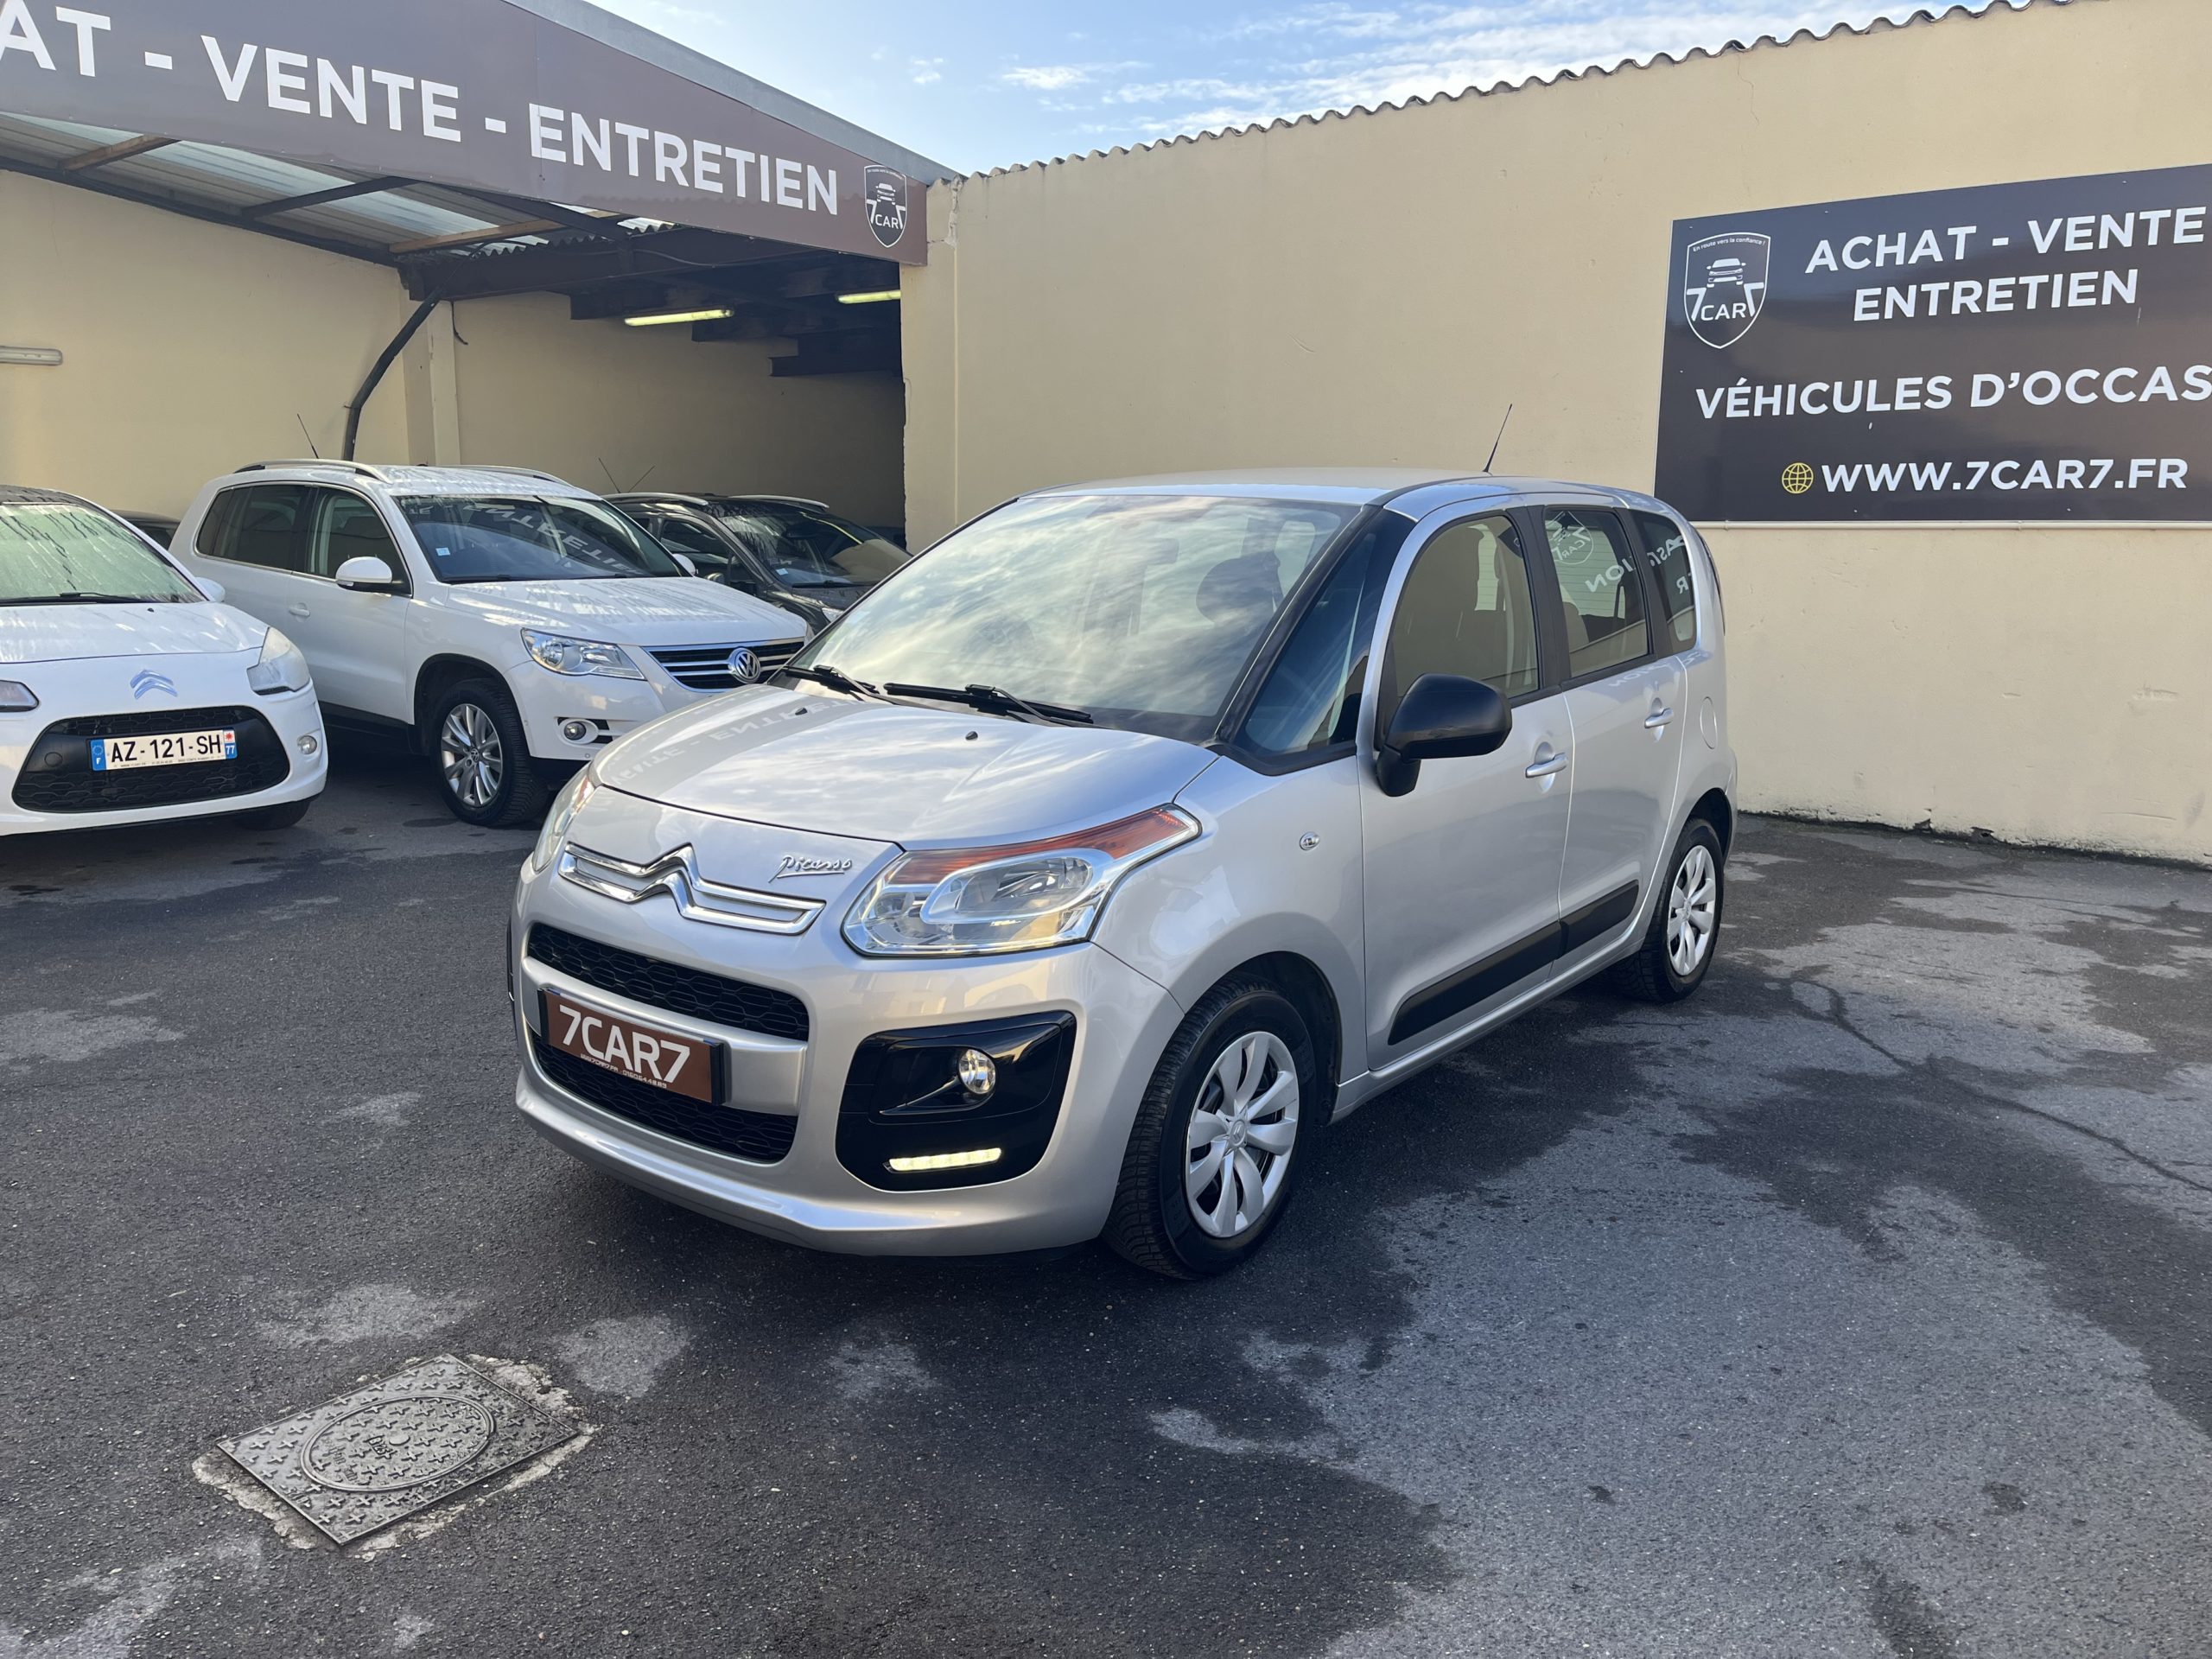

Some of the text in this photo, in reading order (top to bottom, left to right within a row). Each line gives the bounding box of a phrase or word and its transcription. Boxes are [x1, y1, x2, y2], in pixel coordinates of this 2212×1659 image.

[200, 35, 461, 143] VENTE
[528, 103, 837, 215] ENTRETIEN
[1700, 241, 1716, 250] route
[1736, 237, 1763, 245] confiance
[1804, 226, 1977, 274] ACHAT
[2027, 207, 2207, 254] VENTE
[1853, 269, 2139, 321] ENTRETIEN
[1695, 365, 2212, 419] VÉHICULES D'OCCAS
[1821, 458, 2188, 493] WWW.7CAR7.FR
[96, 757, 101, 766] F
[111, 734, 221, 763] AZ-121-SH
[225, 745, 235, 755] 77
[559, 1004, 690, 1084] 7CAR7
